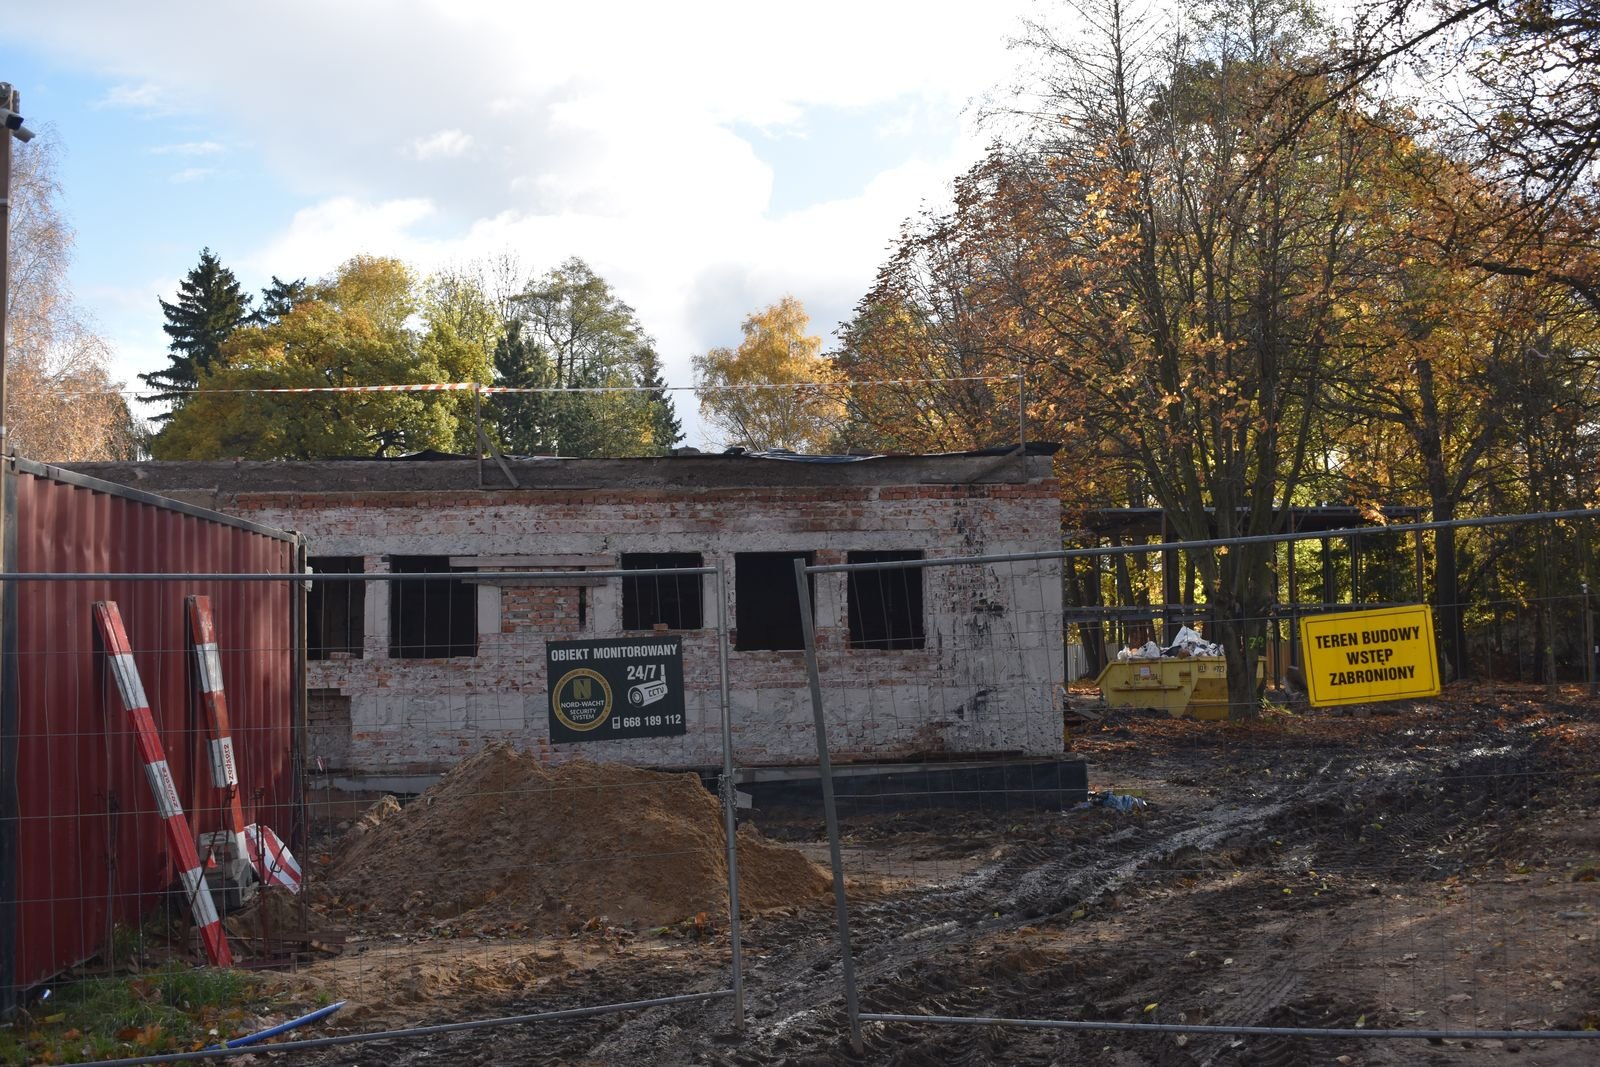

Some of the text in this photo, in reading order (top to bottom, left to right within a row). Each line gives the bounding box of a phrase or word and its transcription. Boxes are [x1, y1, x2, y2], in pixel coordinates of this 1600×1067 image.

[1315, 626, 1420, 649] TEREN BUDOWY
[551, 643, 678, 662] OBIEKT MONITOROWANY
[1346, 648, 1393, 666] WSTĘP
[626, 664, 657, 680] 24/7
[1329, 665, 1415, 686] ZABRONIONY
[573, 678, 592, 700] N
[648, 686, 665, 698] CCTV
[560, 699, 605, 709] NORD-WACHT
[569, 708, 597, 716] SECURITY
[623, 714, 682, 728] 668 189 112
